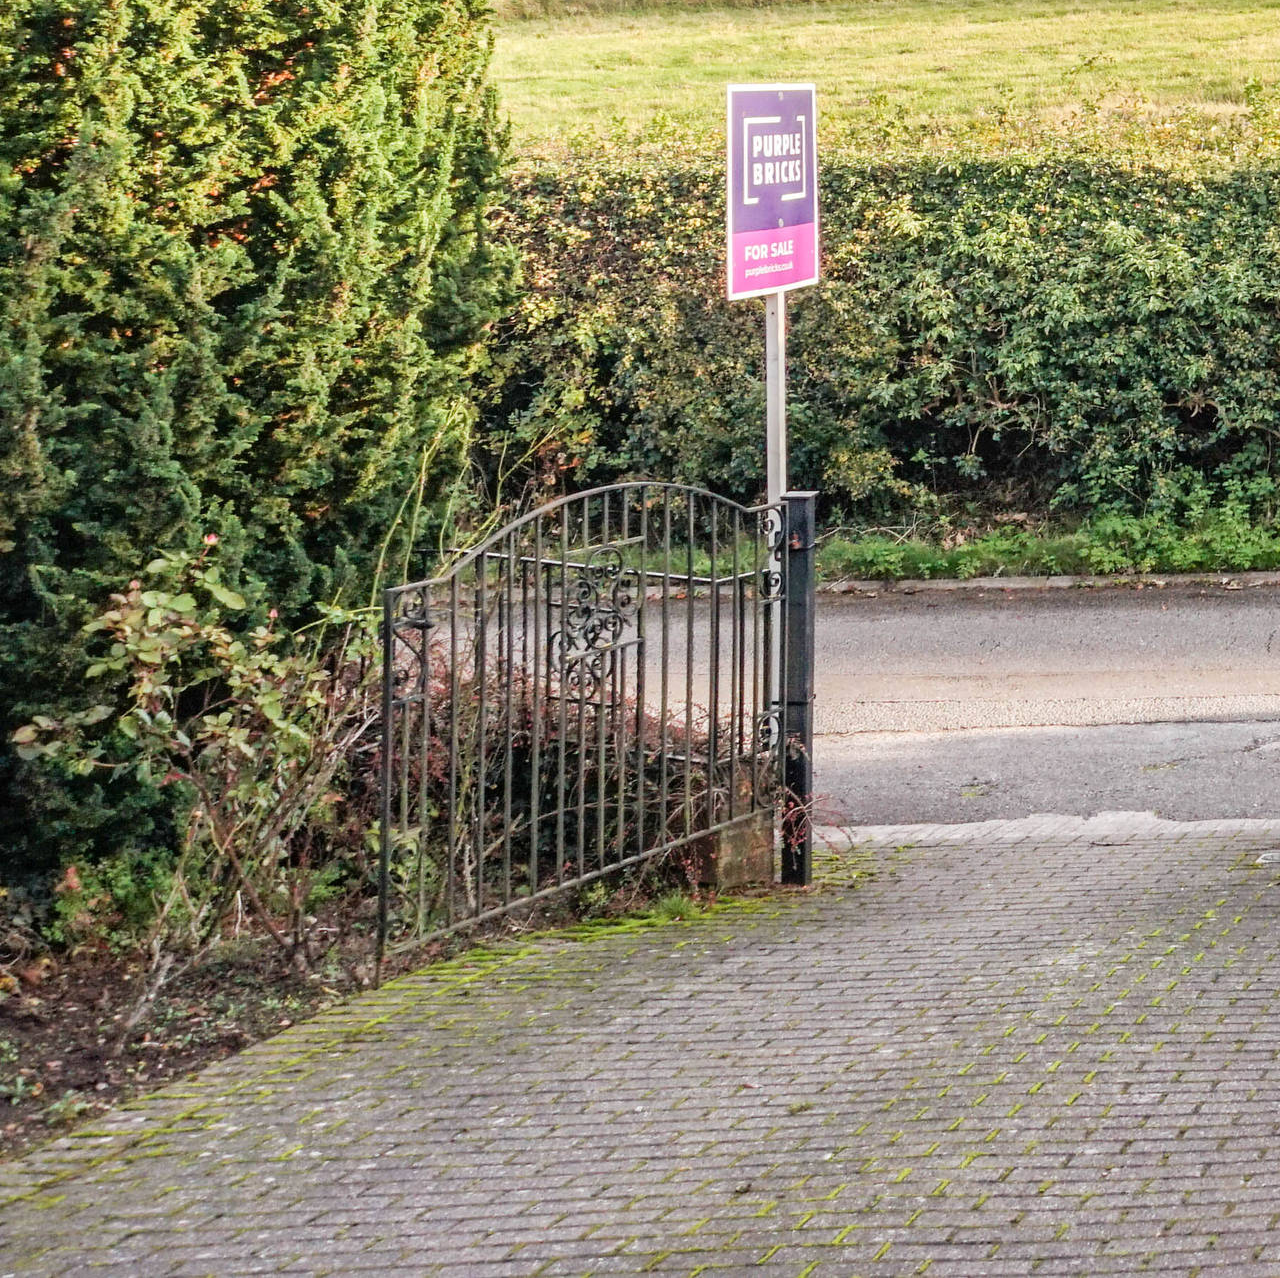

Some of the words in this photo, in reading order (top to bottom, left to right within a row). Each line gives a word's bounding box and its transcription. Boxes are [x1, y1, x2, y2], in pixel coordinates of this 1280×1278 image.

[752, 133, 801, 158] PURPLE
[752, 160, 801, 186] BRICKS
[744, 244, 768, 261] FOR
[770, 240, 794, 257] SALE
